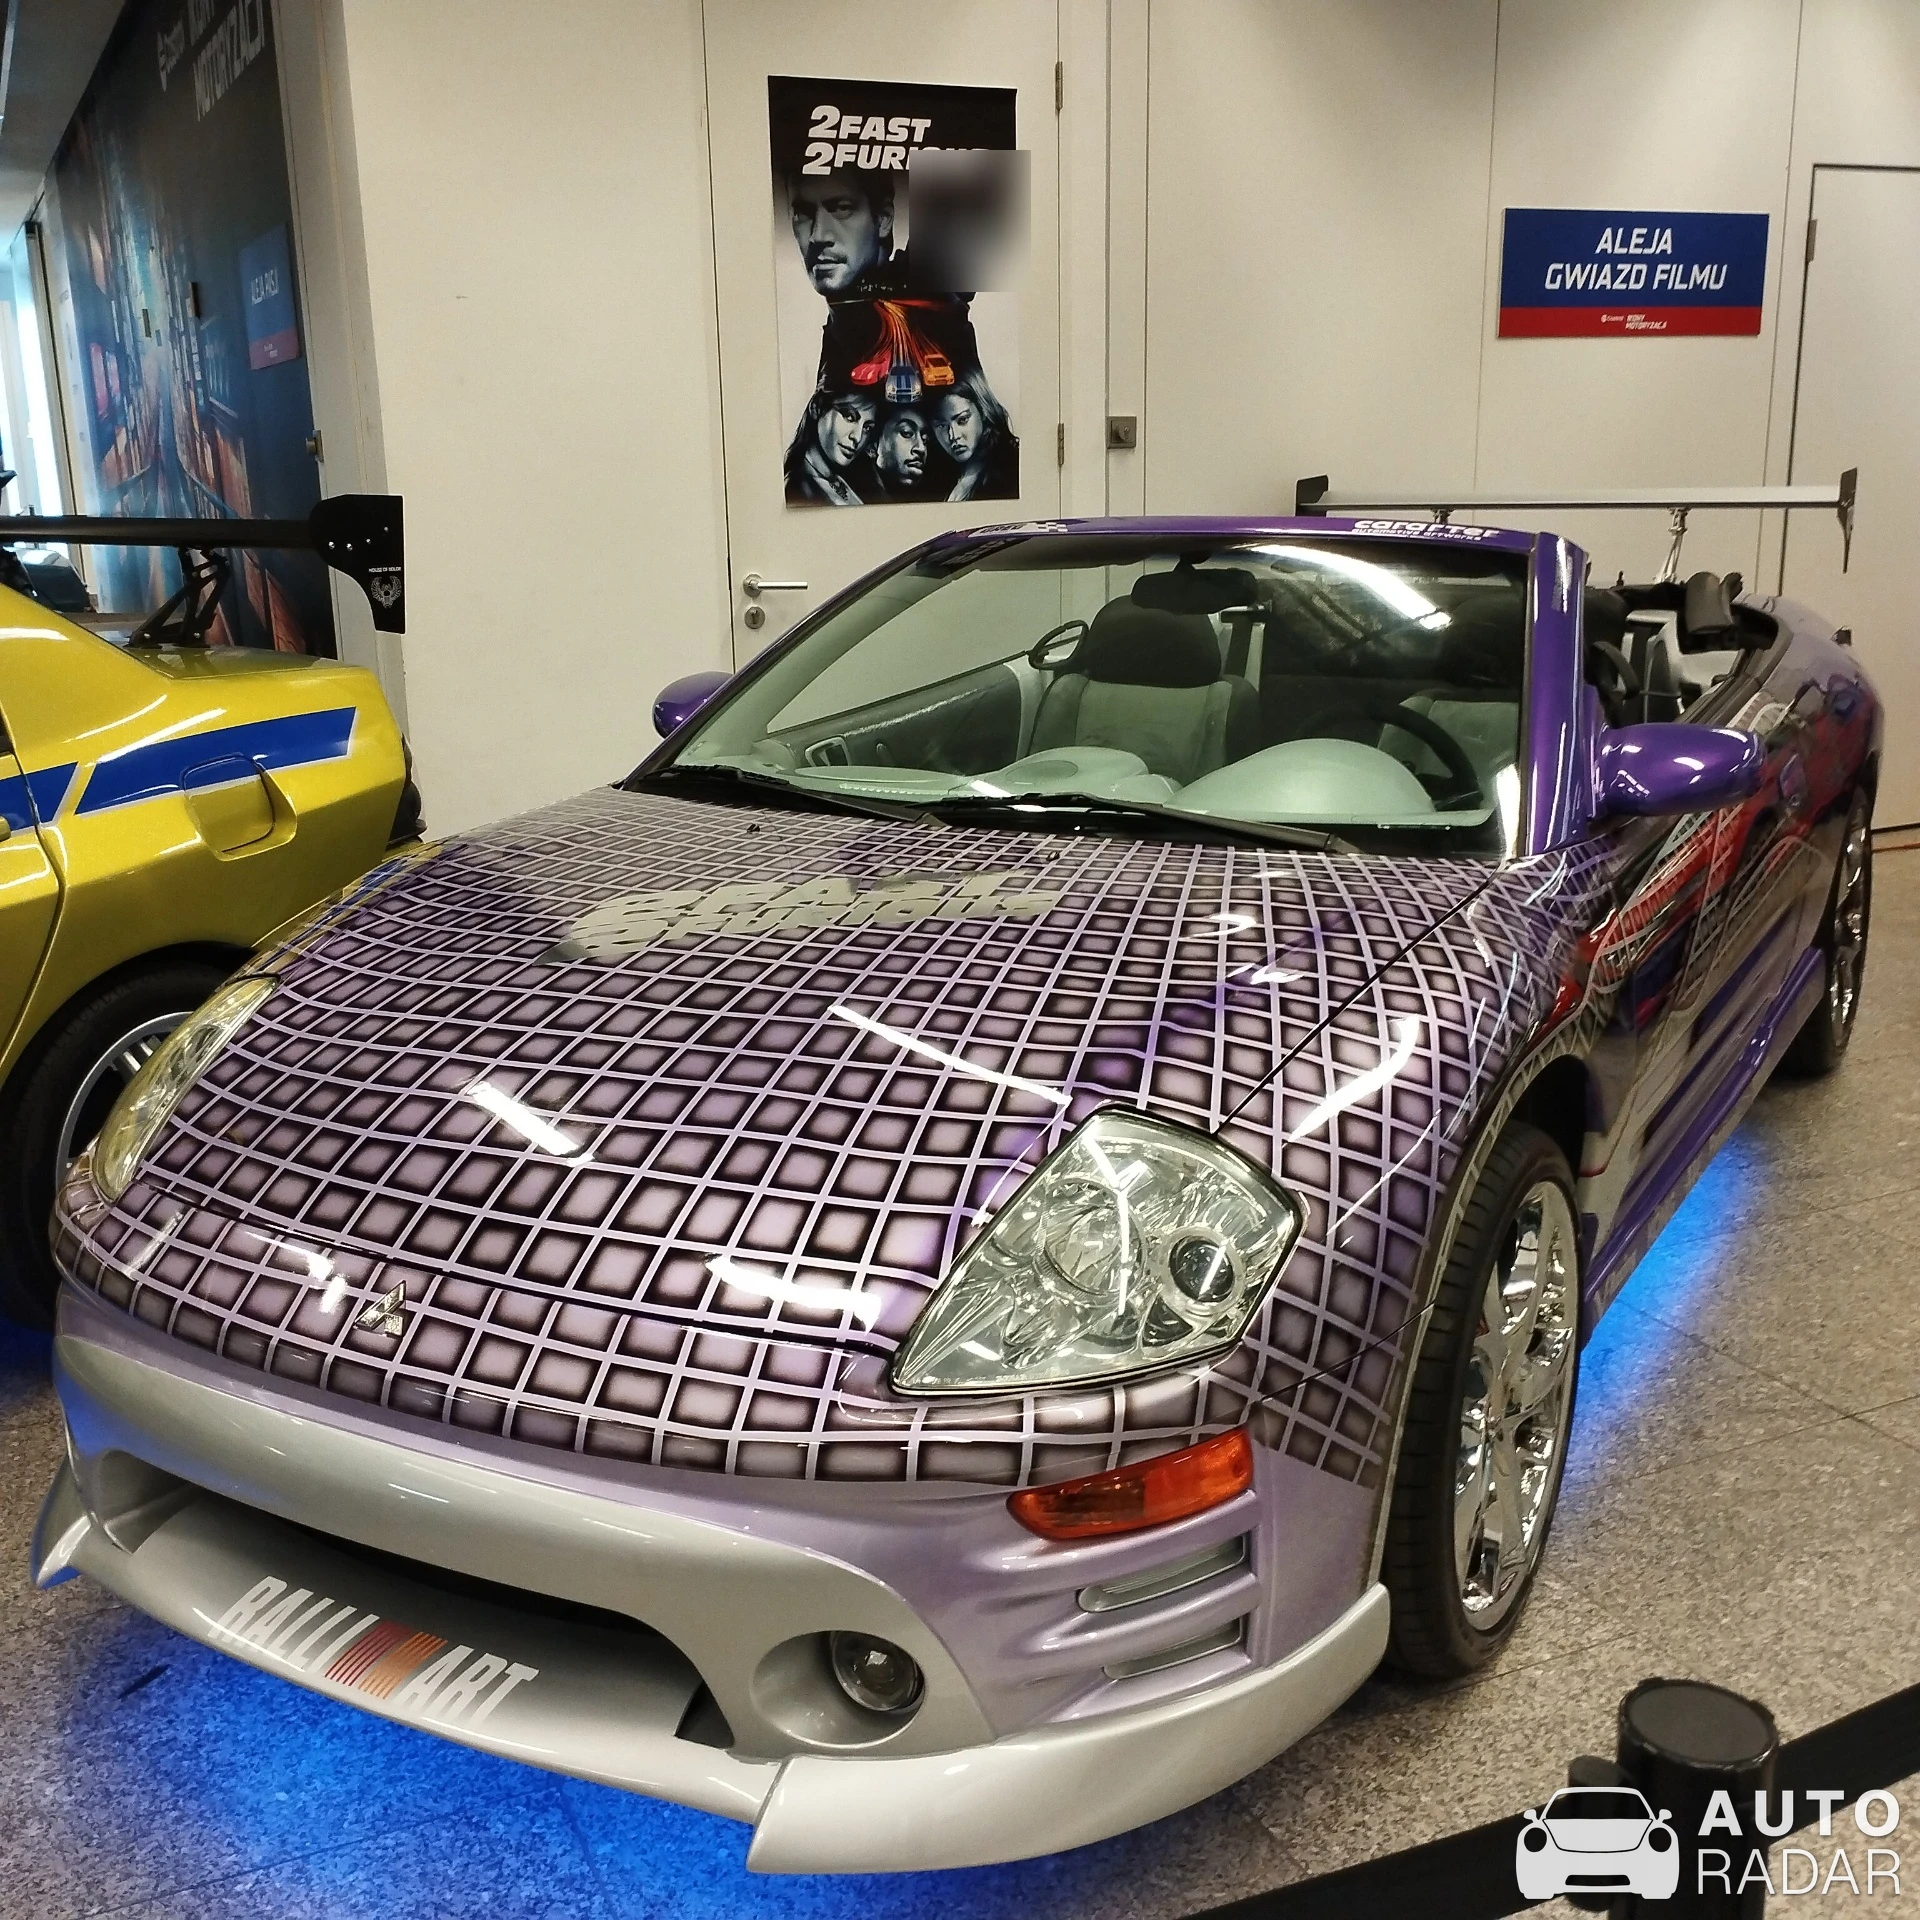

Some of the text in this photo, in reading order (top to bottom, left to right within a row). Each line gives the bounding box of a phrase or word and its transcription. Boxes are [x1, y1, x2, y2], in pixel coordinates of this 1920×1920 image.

[1595, 227, 1672, 255] ALEJA
[1545, 263, 1728, 290] GWIAZD FILMU
